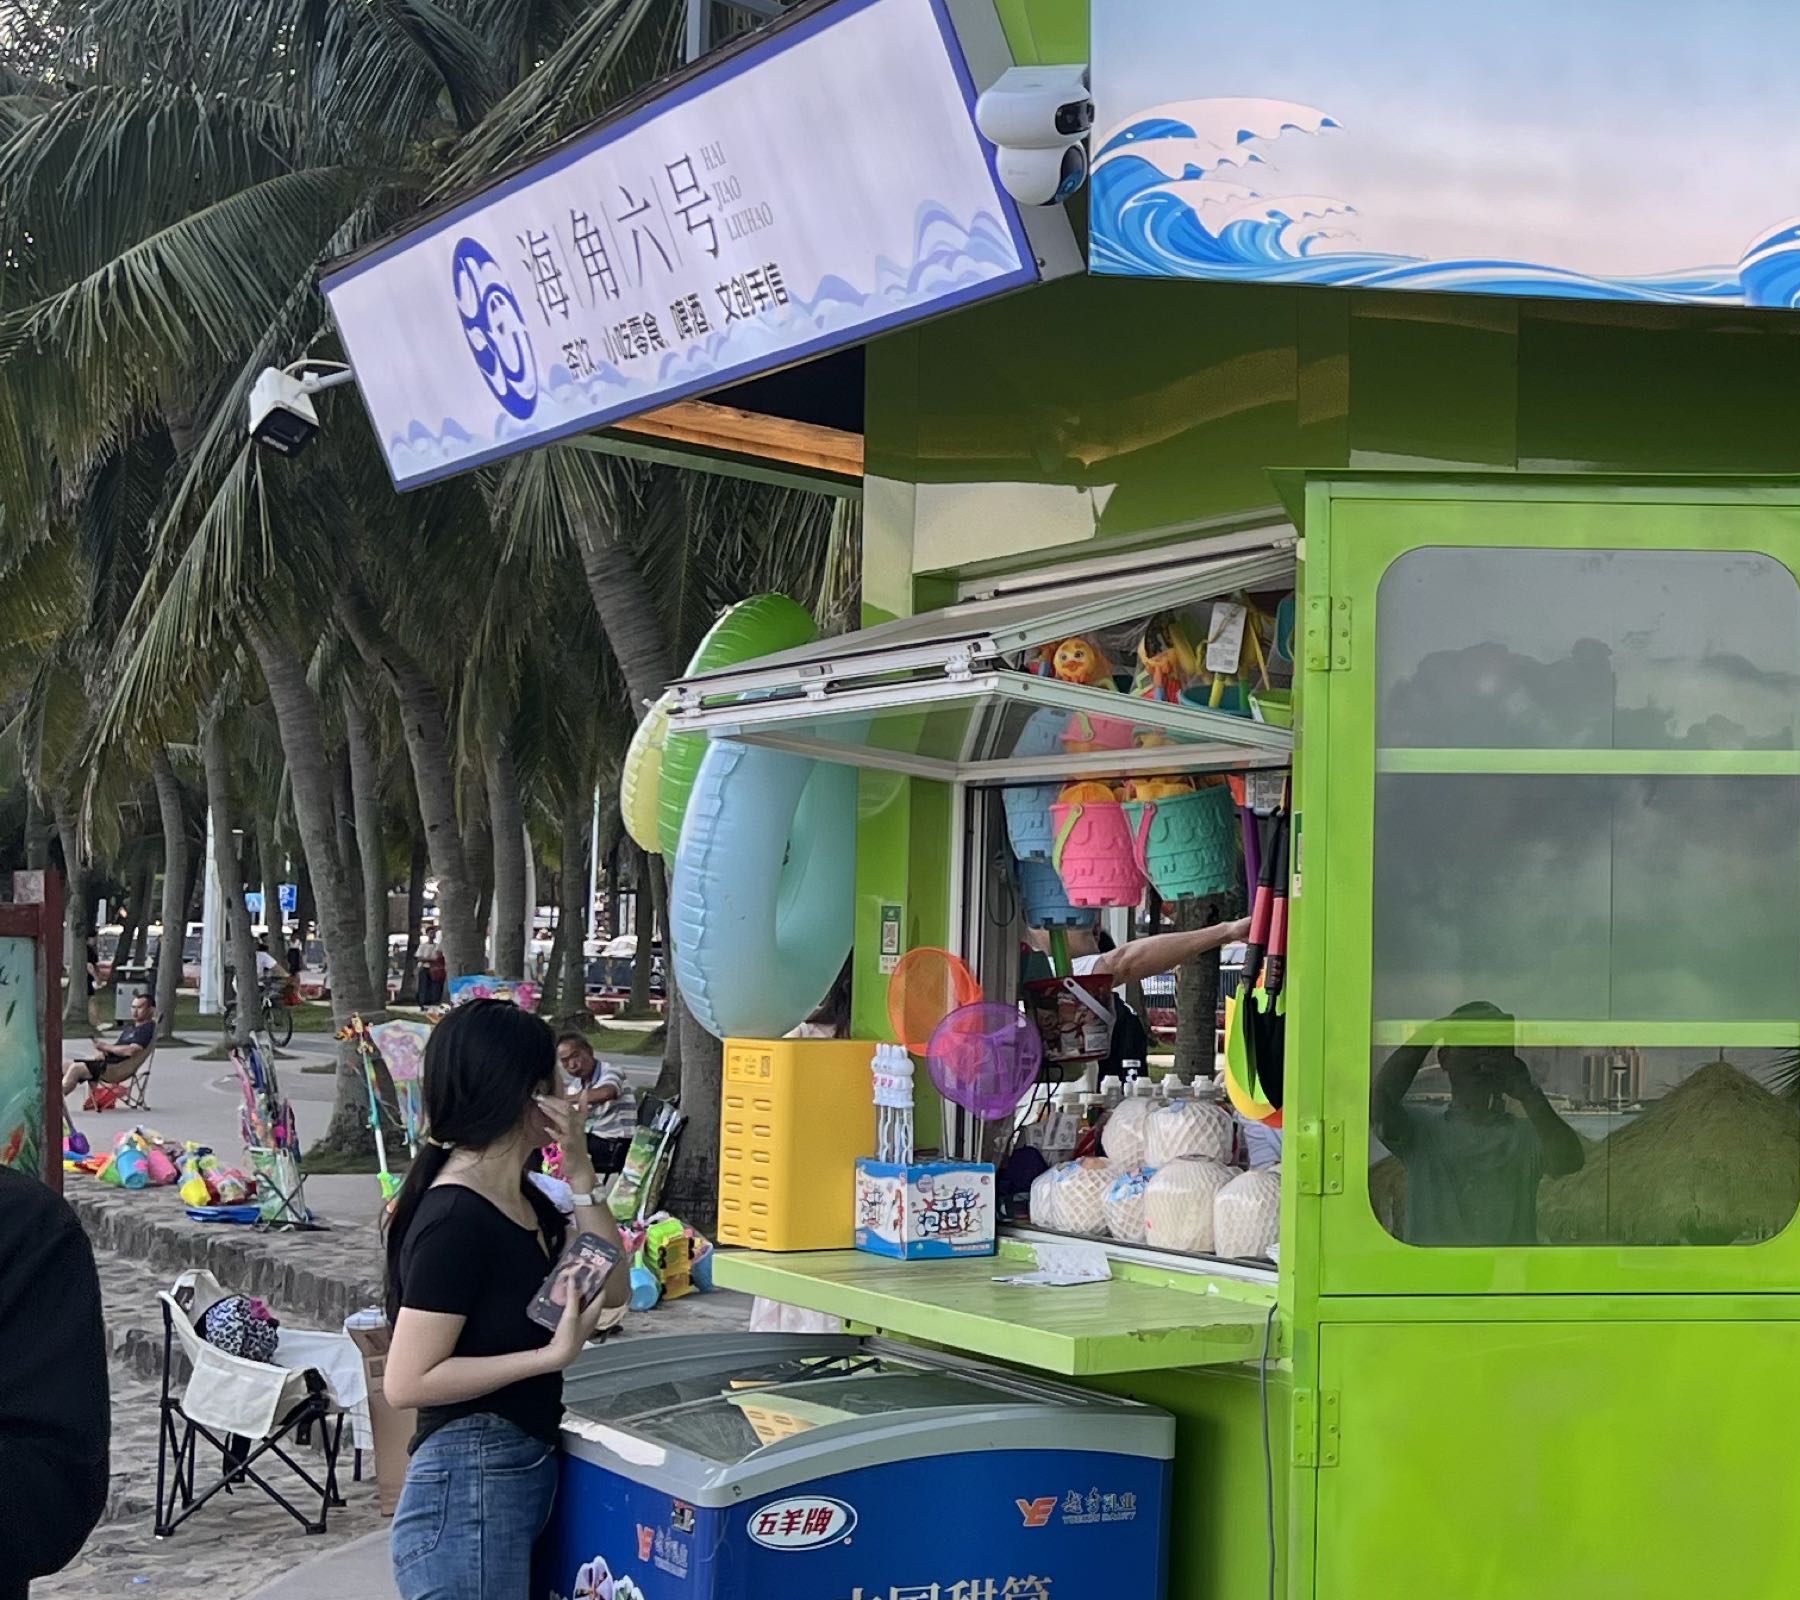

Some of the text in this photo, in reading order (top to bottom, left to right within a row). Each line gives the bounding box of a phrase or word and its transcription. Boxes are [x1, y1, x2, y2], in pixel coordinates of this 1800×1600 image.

[515, 153, 720, 327] 海角六号
[714, 261, 790, 325] 文创手信
[756, 1506, 835, 1537] 五羊牌
